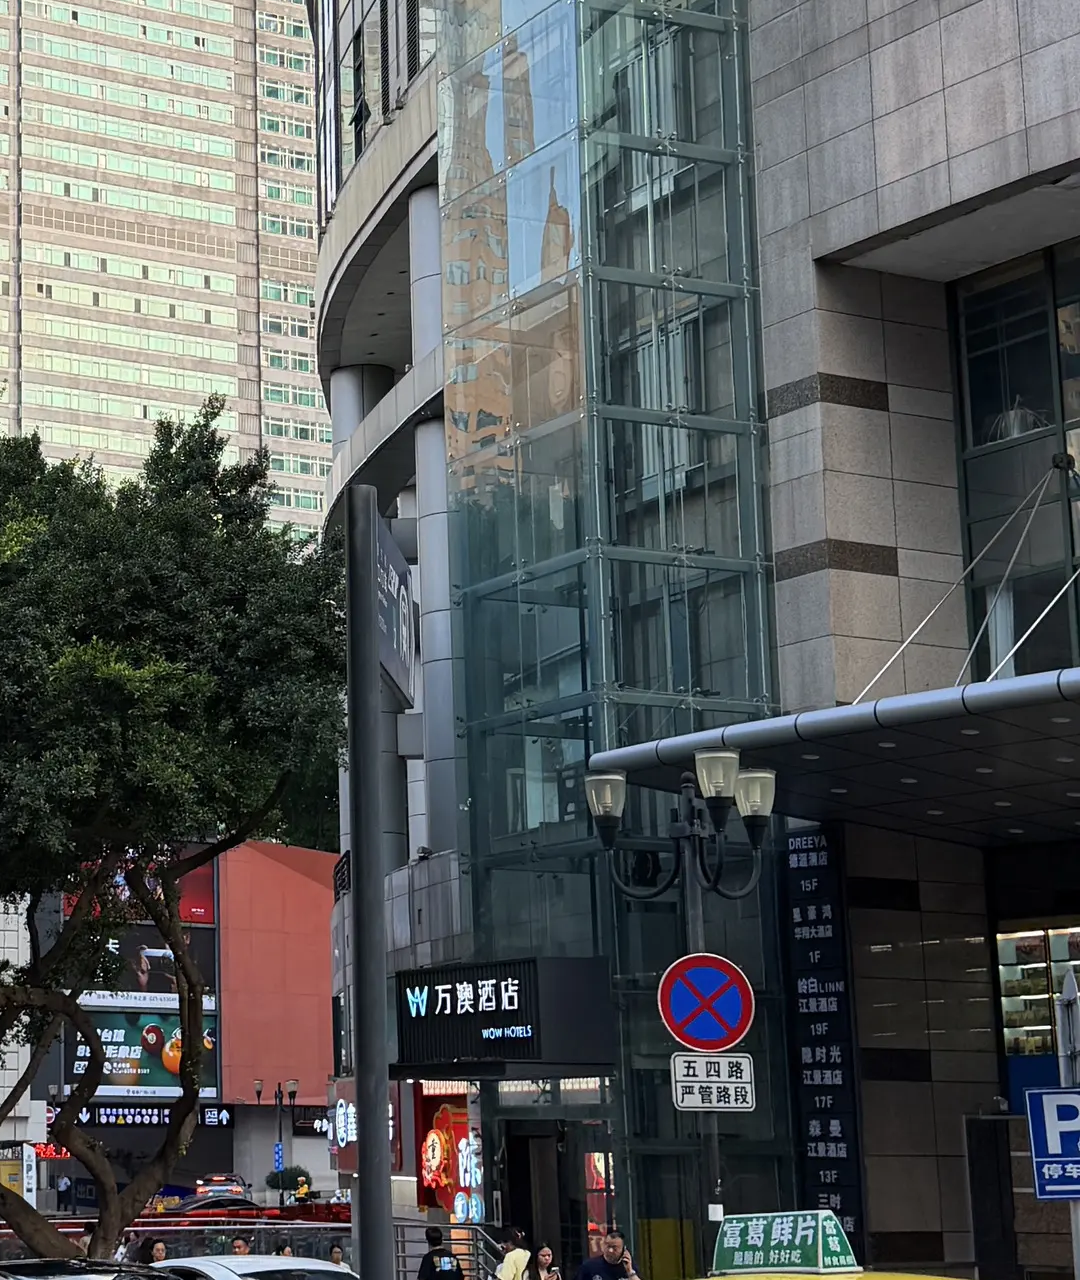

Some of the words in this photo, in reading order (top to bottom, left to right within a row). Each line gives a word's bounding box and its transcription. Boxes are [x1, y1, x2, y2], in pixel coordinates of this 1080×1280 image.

[788, 835, 827, 850] DREEYA
[800, 878, 818, 891] 15F
[809, 951, 821, 963] 1F
[434, 977, 520, 1015] 万澳酒店
[482, 1027, 503, 1039] WOW
[504, 1024, 532, 1038] HOTELS
[810, 1023, 829, 1036] 19F
[682, 1060, 744, 1080] 五四路
[680, 1085, 749, 1105] 严管路段
[814, 1096, 833, 1108] 17F
[1042, 1094, 1080, 1154] P
[819, 1170, 838, 1183] 13F
[723, 1215, 816, 1248] 富葛鲜片
